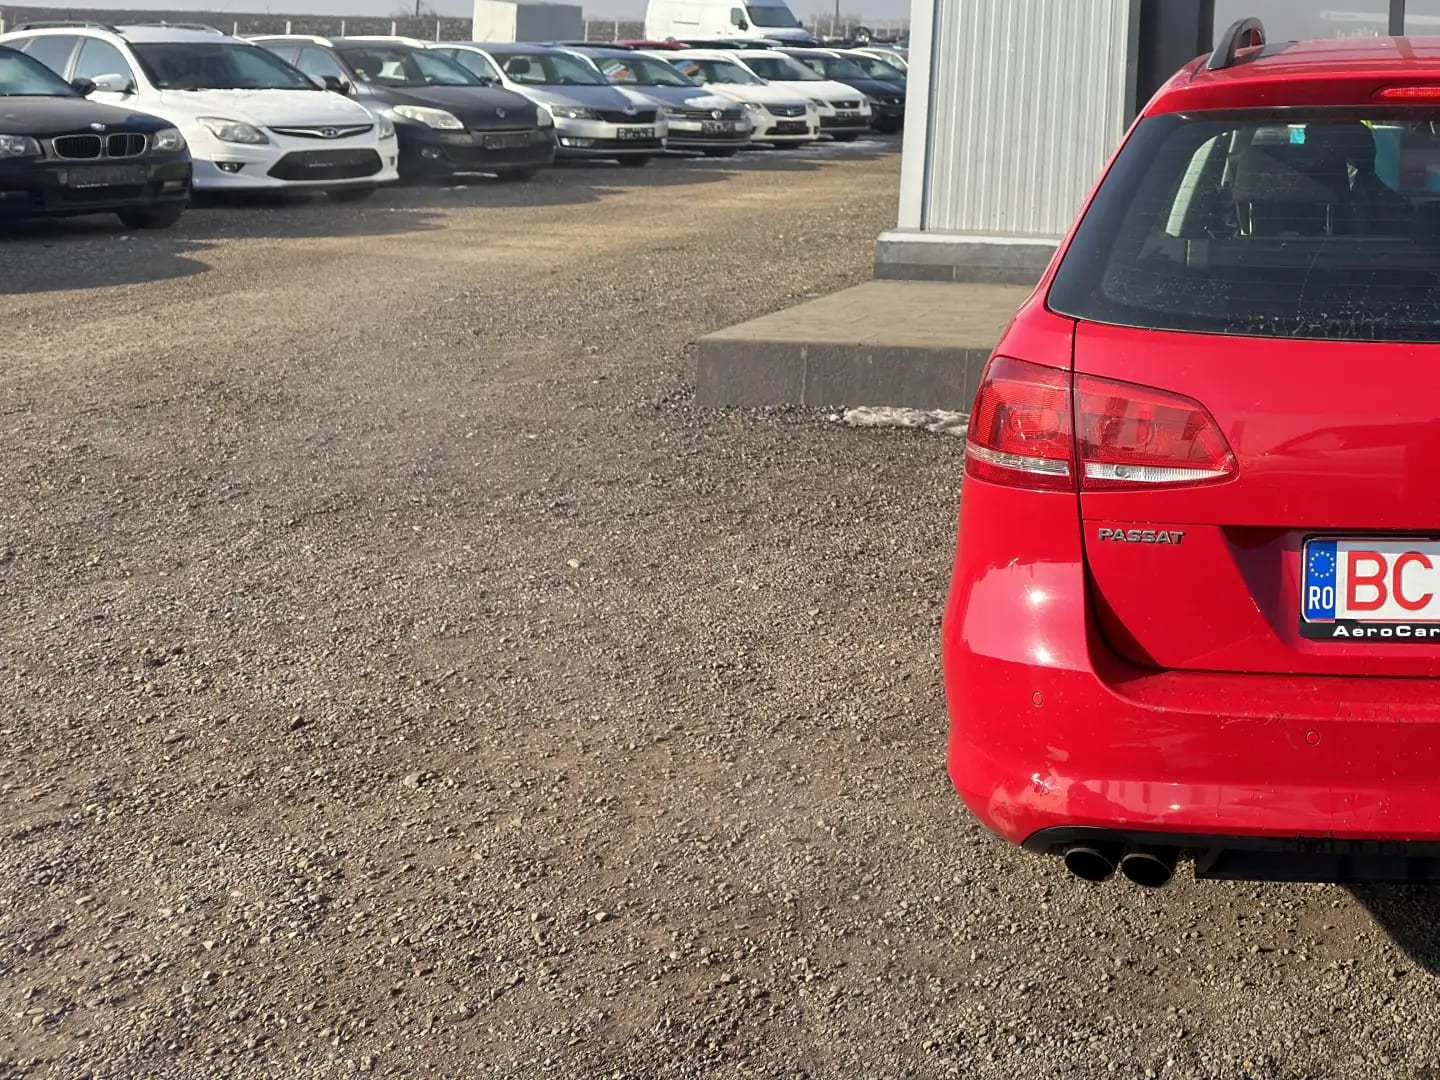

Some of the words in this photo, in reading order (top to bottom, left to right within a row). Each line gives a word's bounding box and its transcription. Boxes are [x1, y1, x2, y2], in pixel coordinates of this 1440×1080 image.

[1097, 527, 1185, 544] PASSAT
[1346, 550, 1433, 611] BC
[1308, 586, 1334, 610] RO
